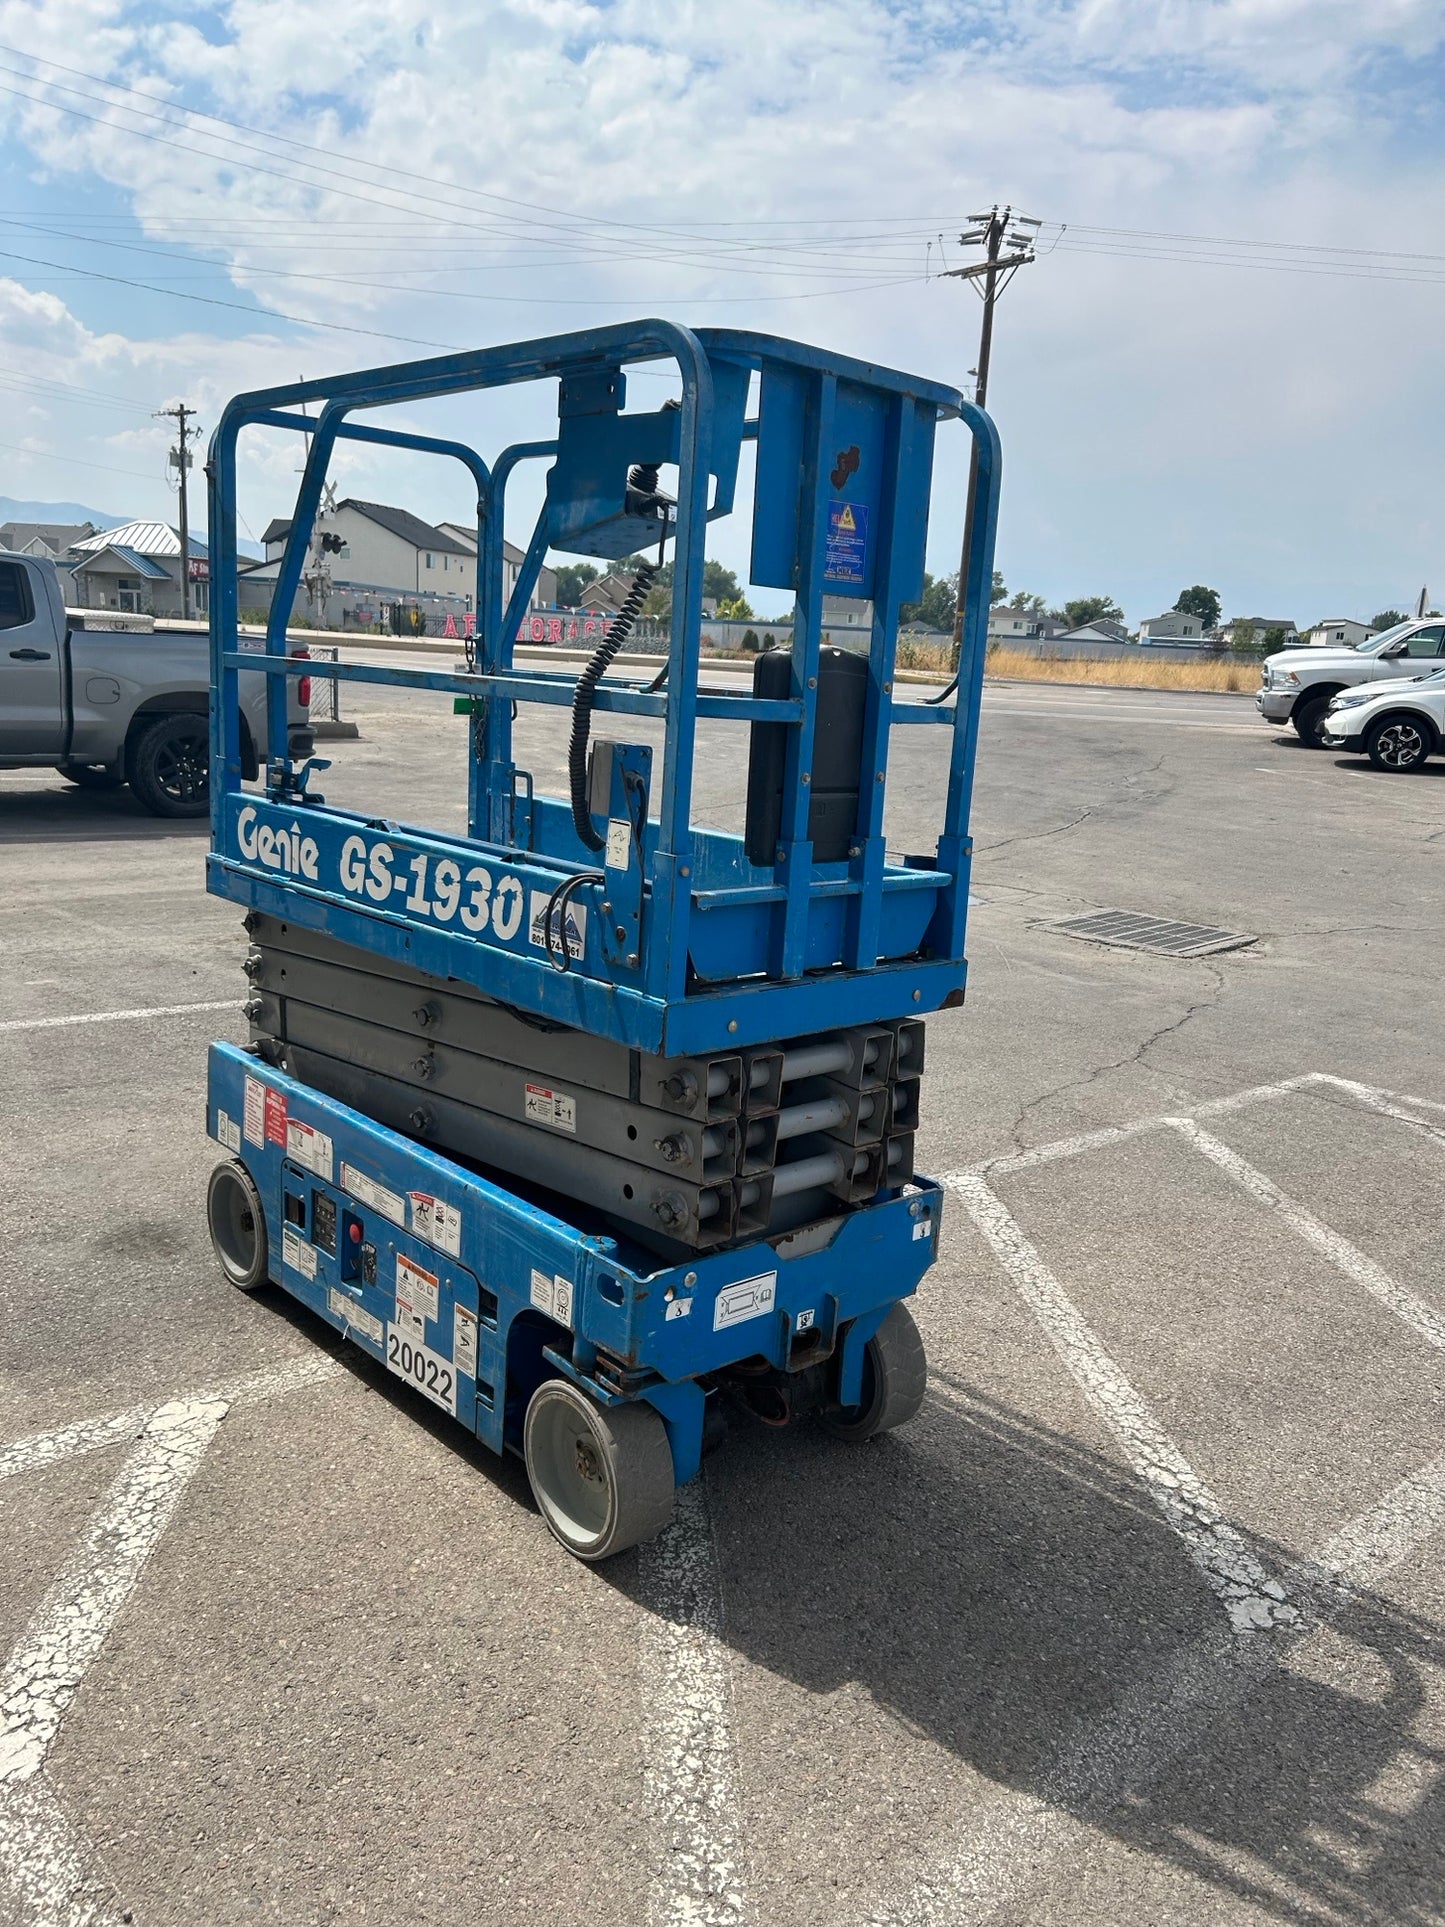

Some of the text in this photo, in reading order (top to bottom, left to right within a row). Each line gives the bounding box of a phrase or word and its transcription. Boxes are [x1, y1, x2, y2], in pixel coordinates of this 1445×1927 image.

[443, 613, 477, 638] AF
[237, 806, 524, 941] Genie GS-1930
[389, 1333, 453, 1405] 20022
